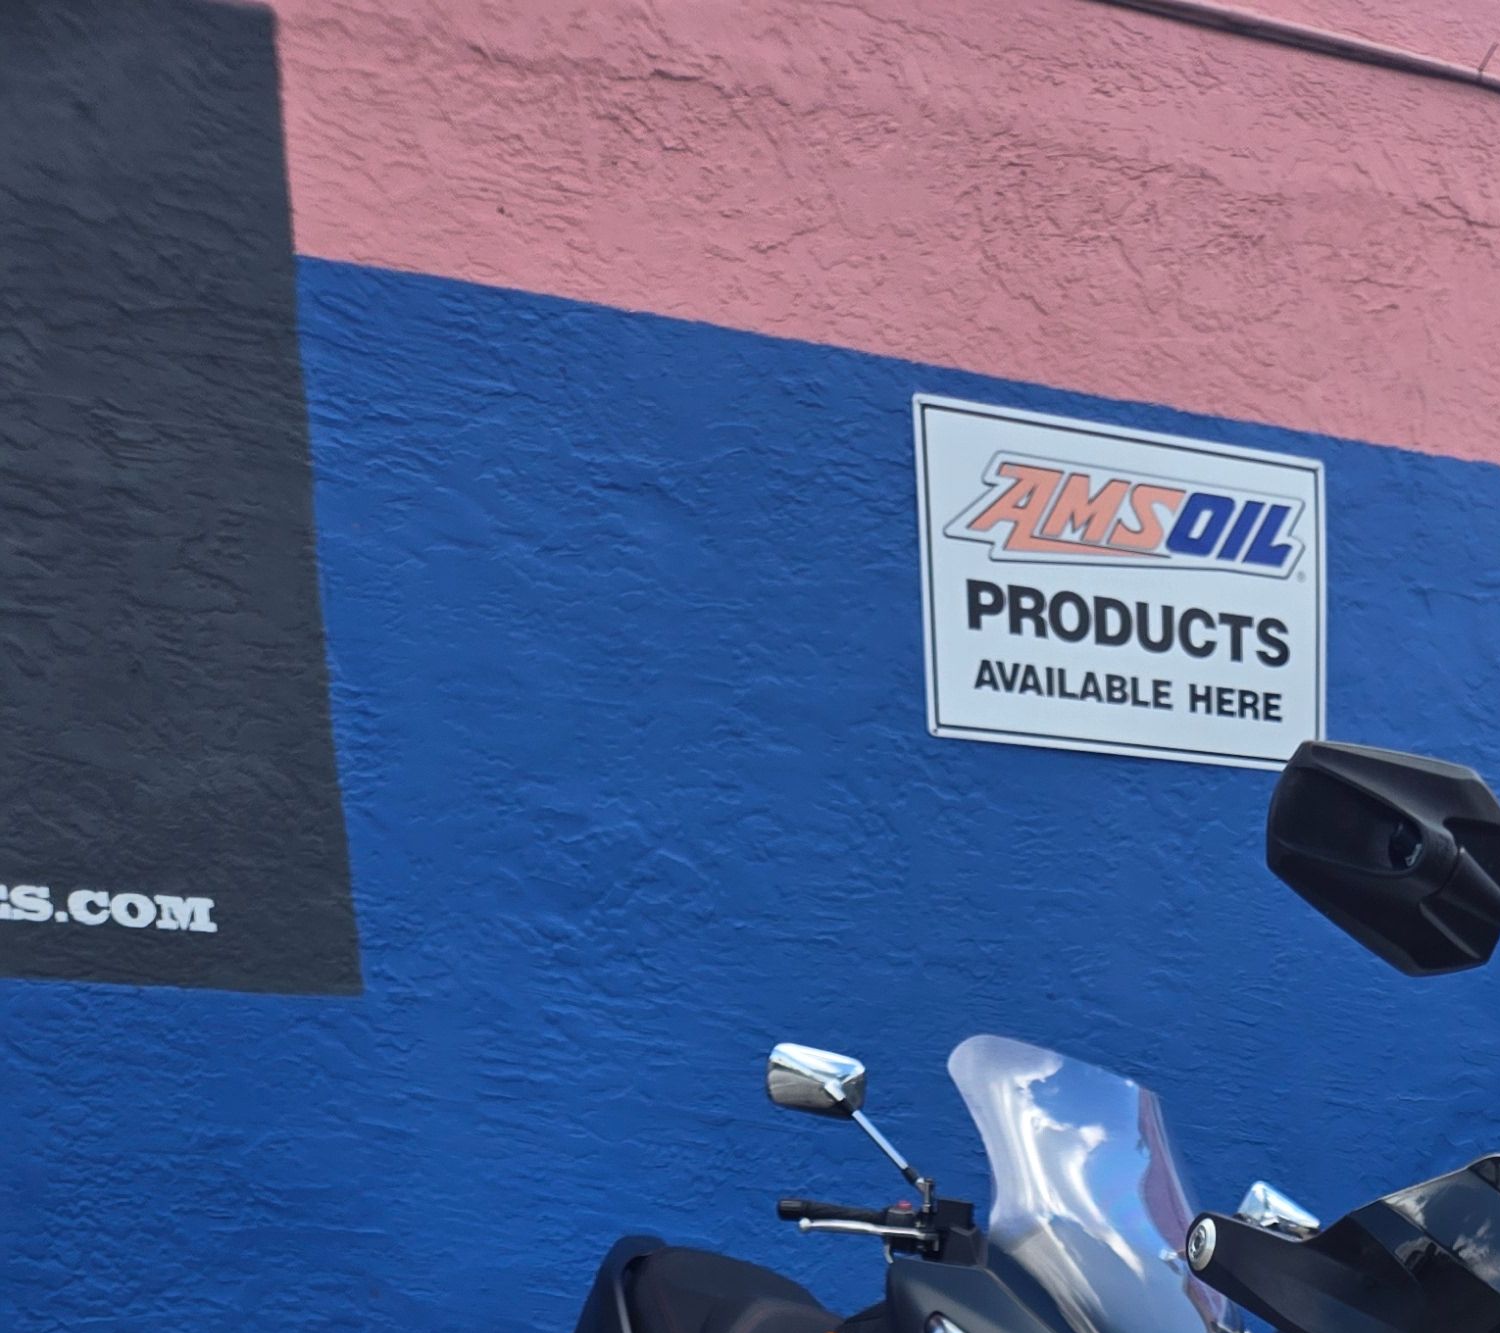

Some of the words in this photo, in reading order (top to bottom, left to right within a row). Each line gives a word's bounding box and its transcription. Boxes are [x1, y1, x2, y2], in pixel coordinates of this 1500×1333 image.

[966, 461, 1292, 568] AMSOIL
[965, 578, 1291, 668] PRODUCTS
[973, 659, 1174, 710] AVAILABLE
[1188, 683, 1284, 723] HERE
